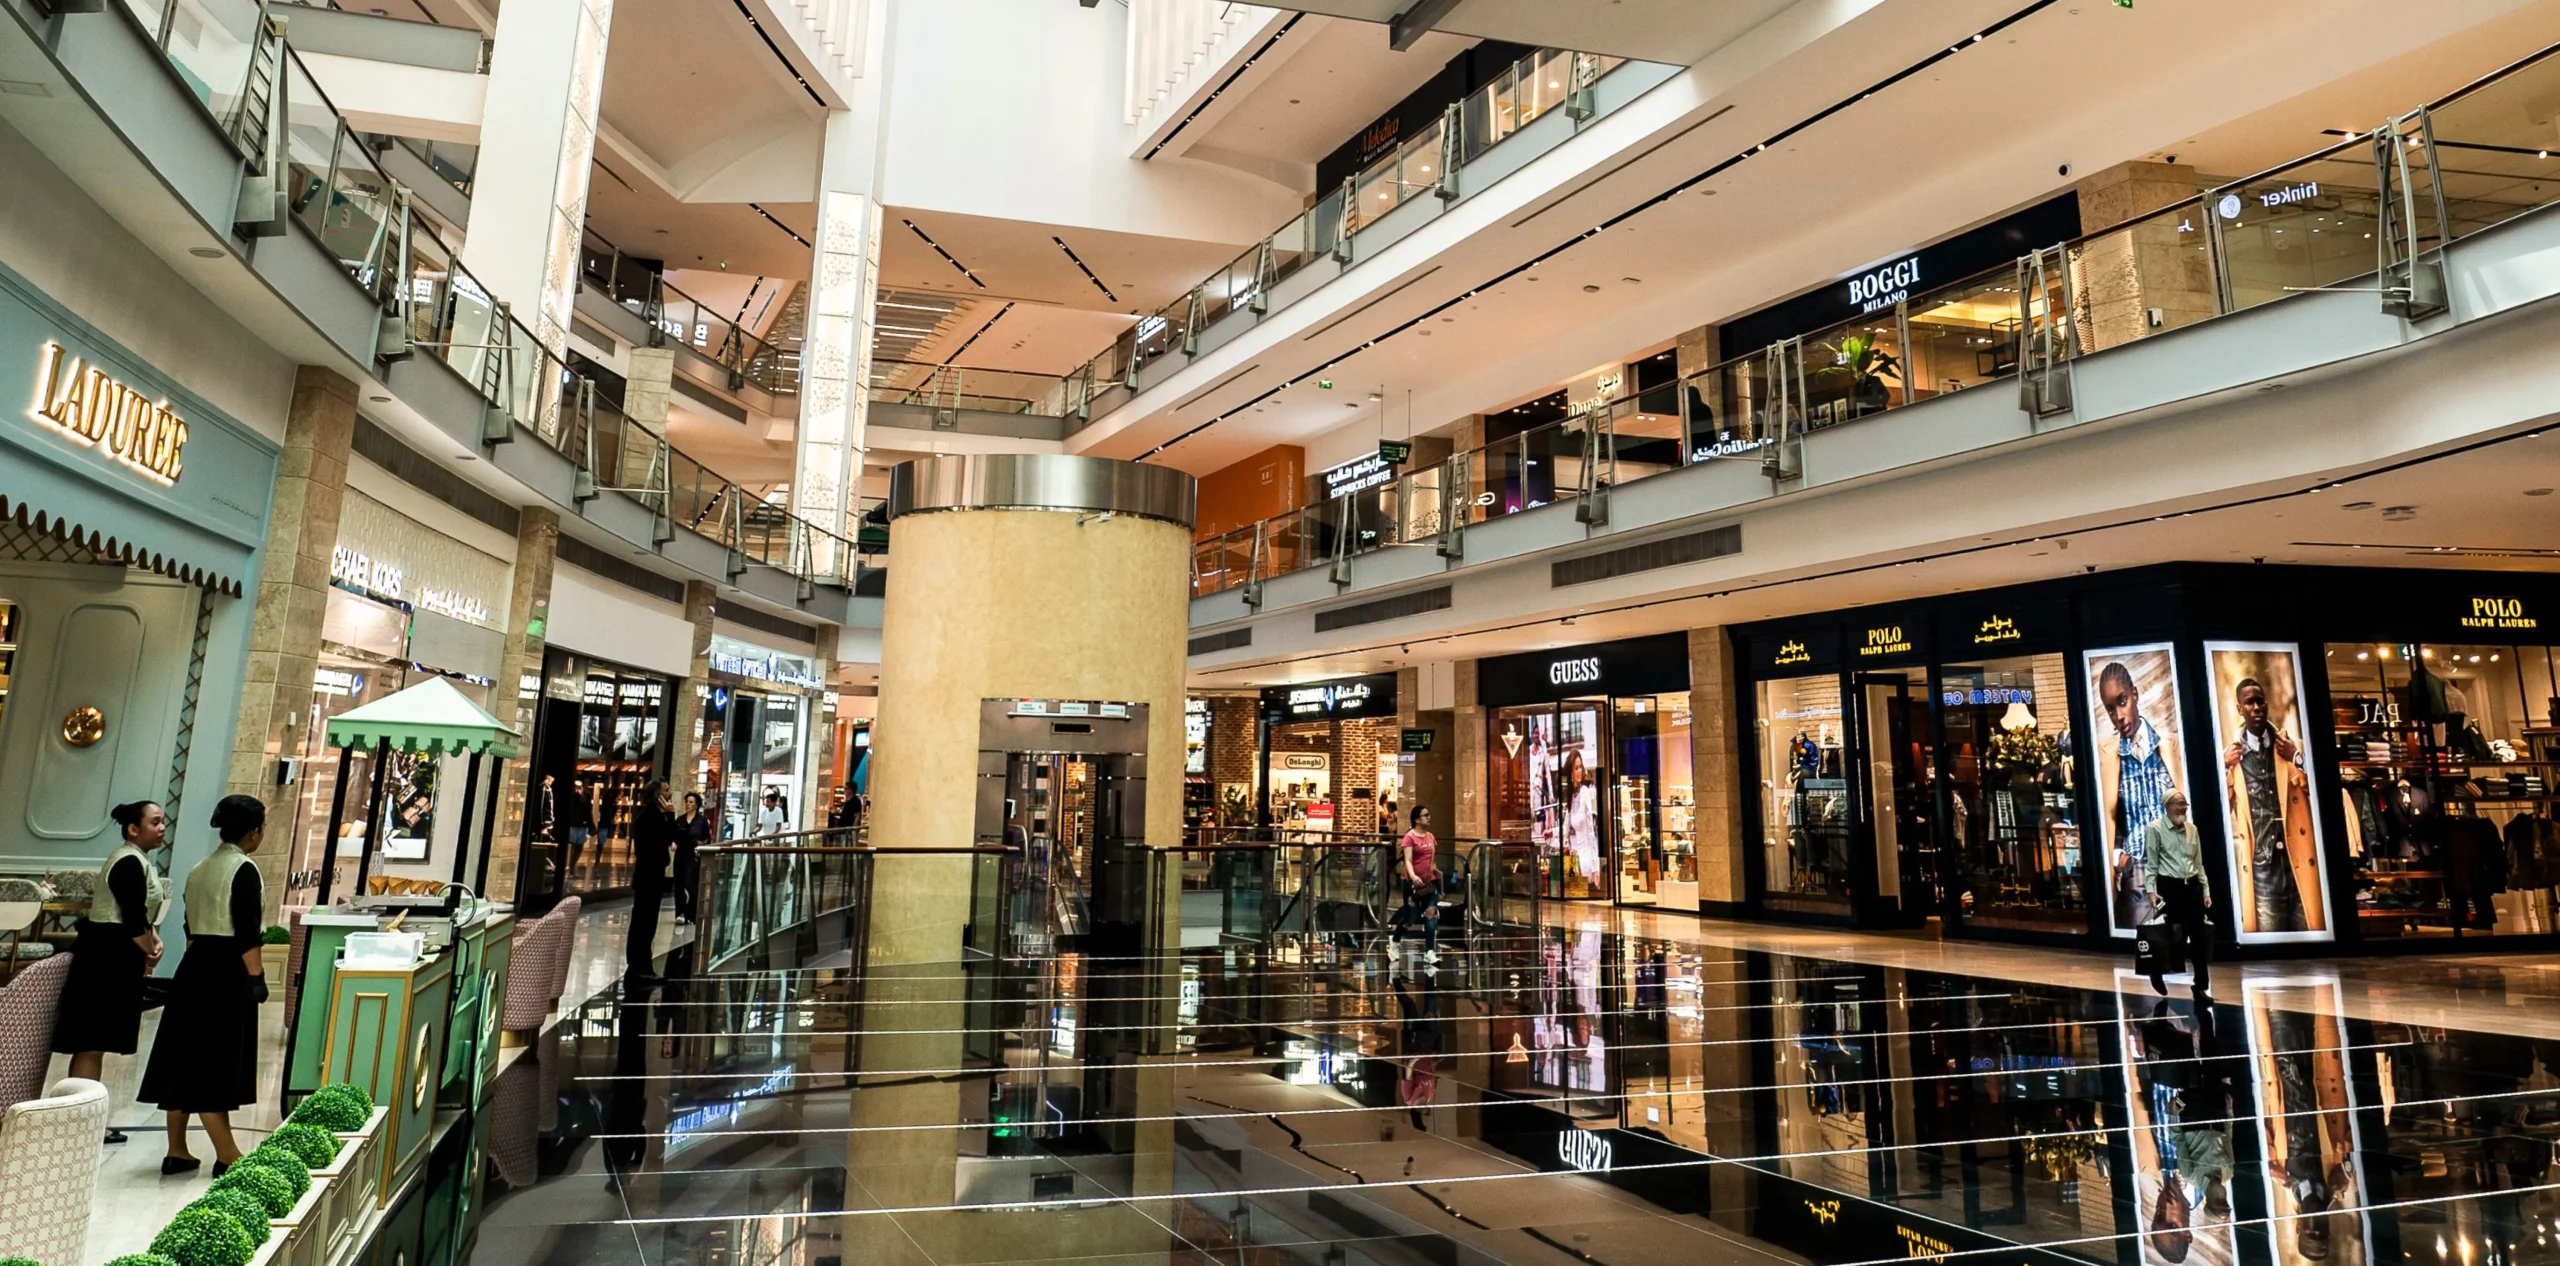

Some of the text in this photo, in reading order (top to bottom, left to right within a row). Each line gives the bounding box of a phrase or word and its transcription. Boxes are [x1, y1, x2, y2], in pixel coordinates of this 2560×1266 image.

[1848, 257, 1920, 305] BOGGI
[1863, 290, 1908, 313] MILANO
[37, 341, 190, 484] LADURÉE
[1331, 469, 1391, 499] STARBUCKS COFFEE
[371, 561, 403, 599] KORS
[2472, 597, 2522, 618] POLO
[1980, 614, 2013, 632] بولو
[2461, 617, 2537, 628] RALPH LAUREN
[1868, 625, 1902, 646] POLO
[1780, 639, 1805, 655] بولو
[1860, 642, 1912, 656] RALPH LAUREN
[1550, 657, 1599, 684] GUESS
